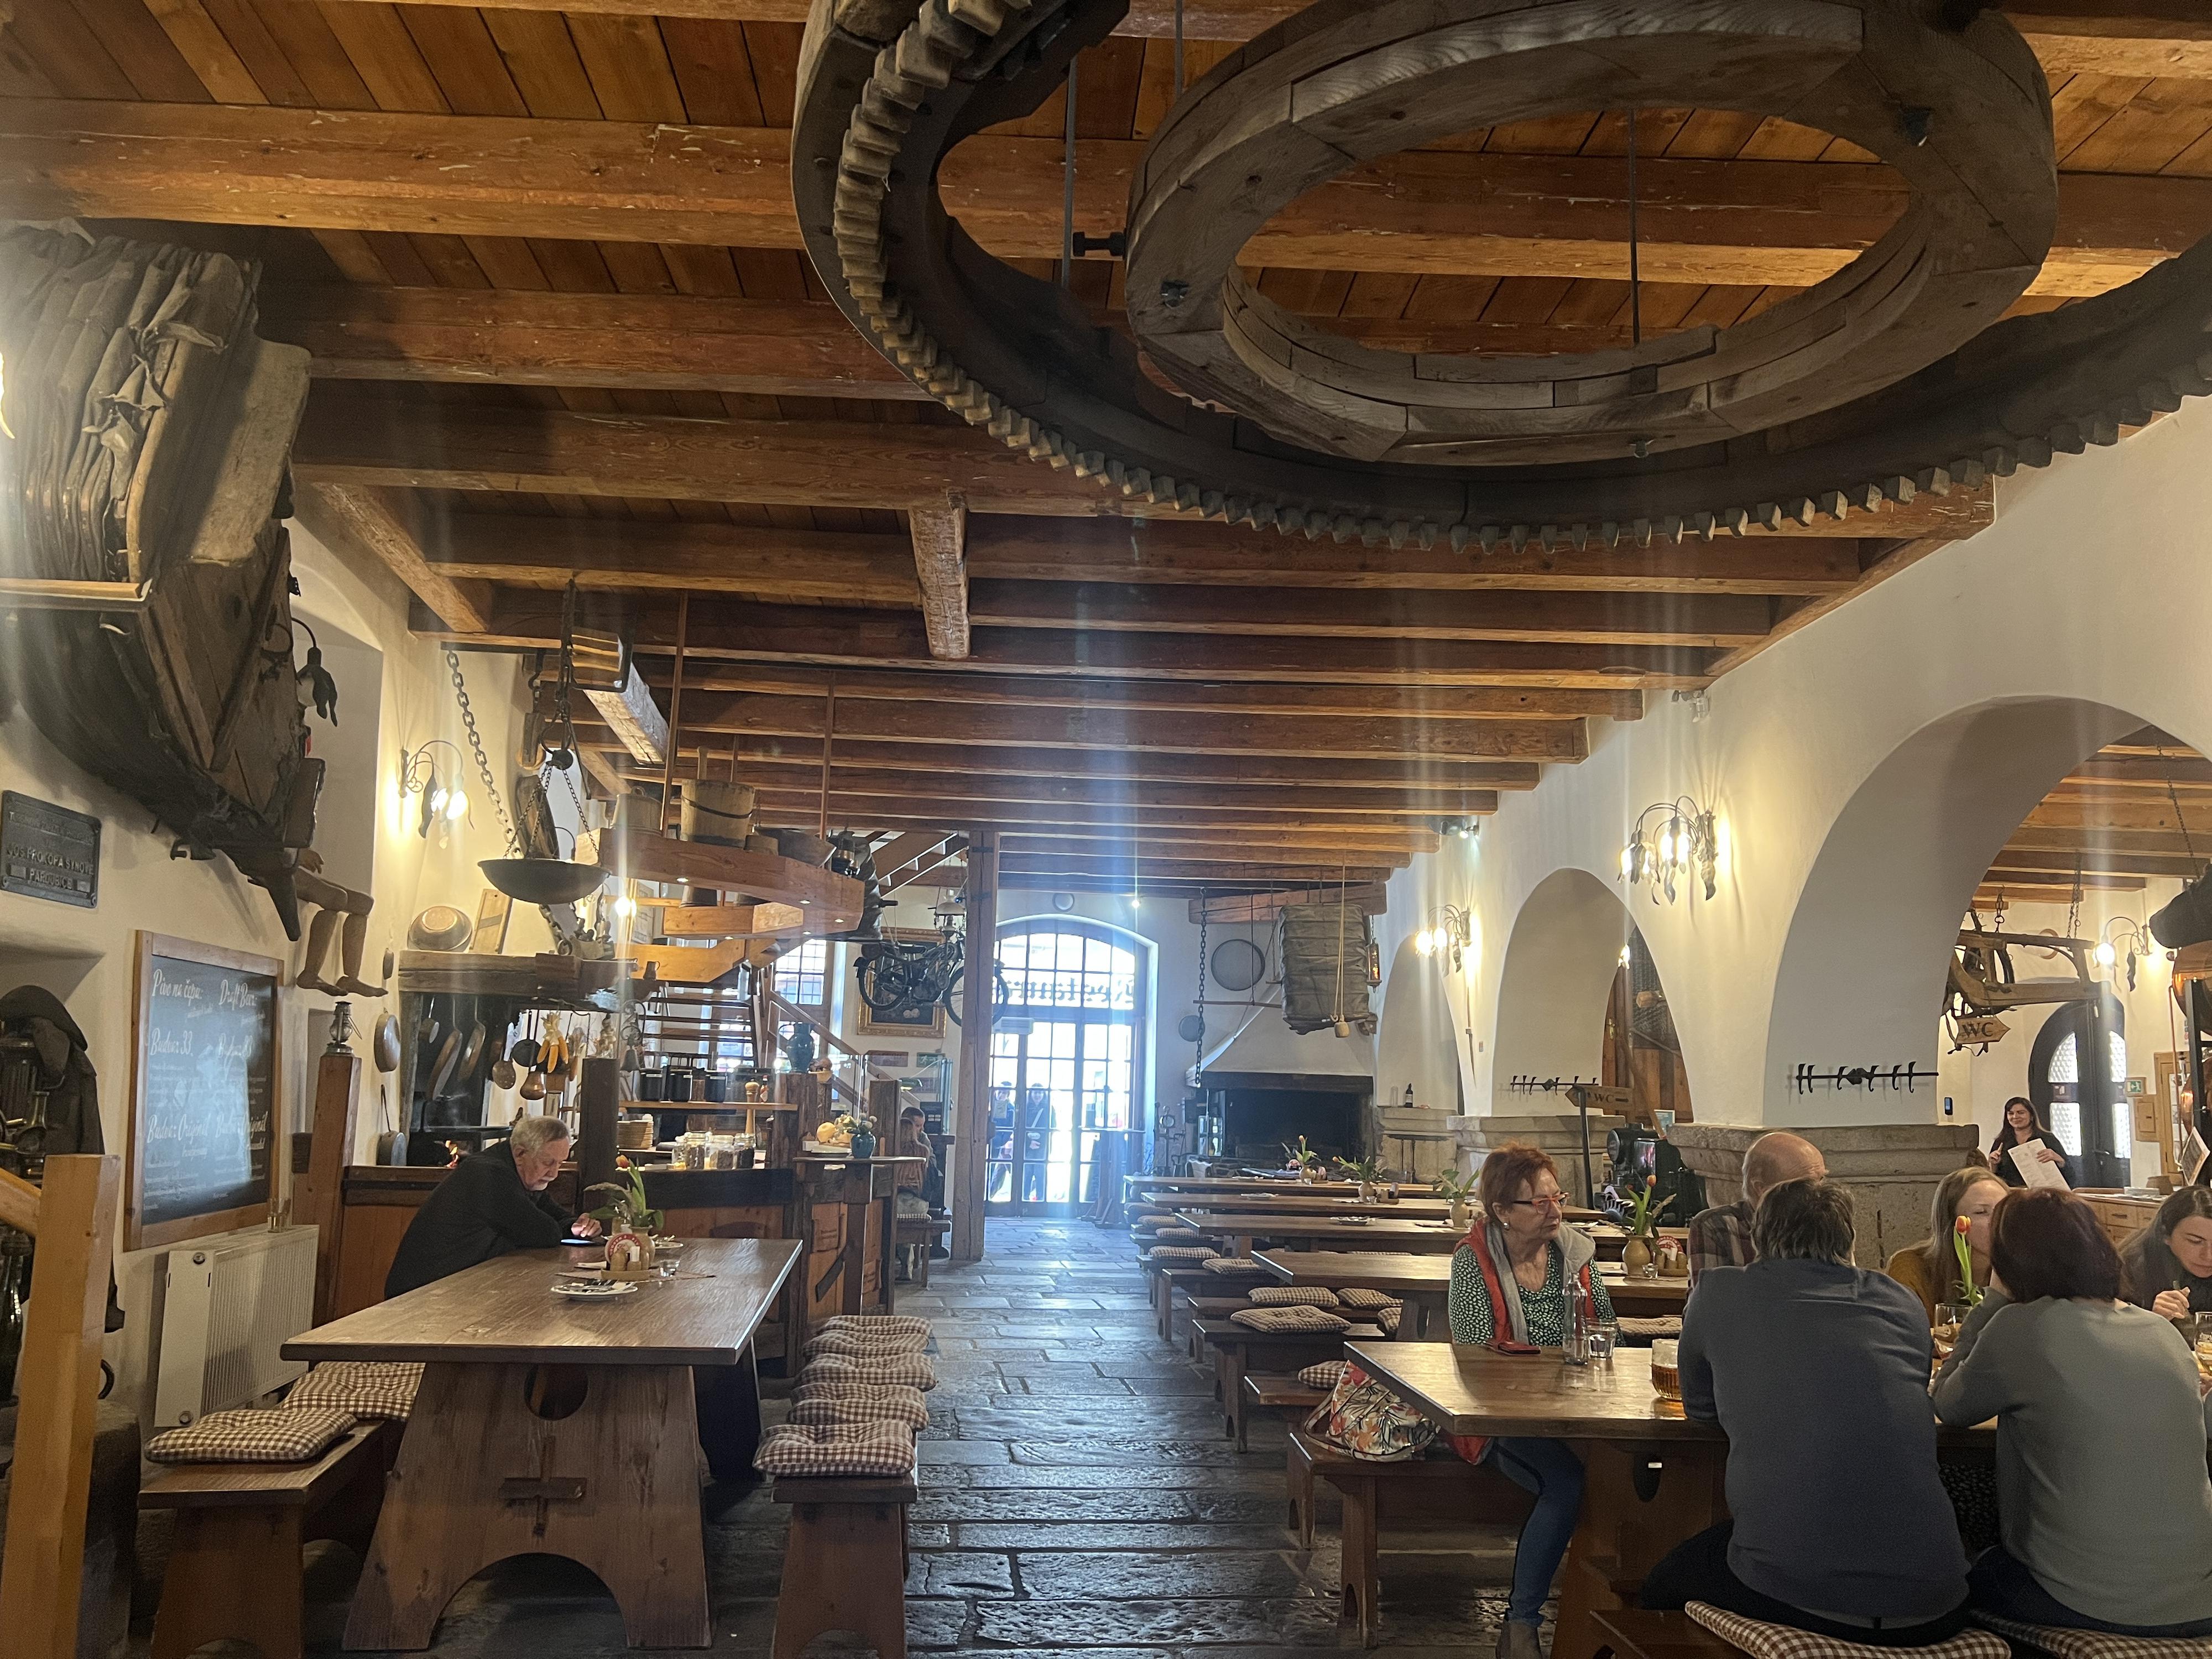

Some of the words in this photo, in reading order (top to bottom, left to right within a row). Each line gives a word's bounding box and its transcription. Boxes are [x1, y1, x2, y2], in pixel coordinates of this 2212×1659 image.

[30, 868, 73, 890] PARDUBICE
[152, 969, 171, 997] Pivo
[172, 984, 182, 997] na
[218, 979, 241, 1011] Draft
[1962, 1022, 1993, 1037] WC
[1594, 1093, 1615, 1103] WC
